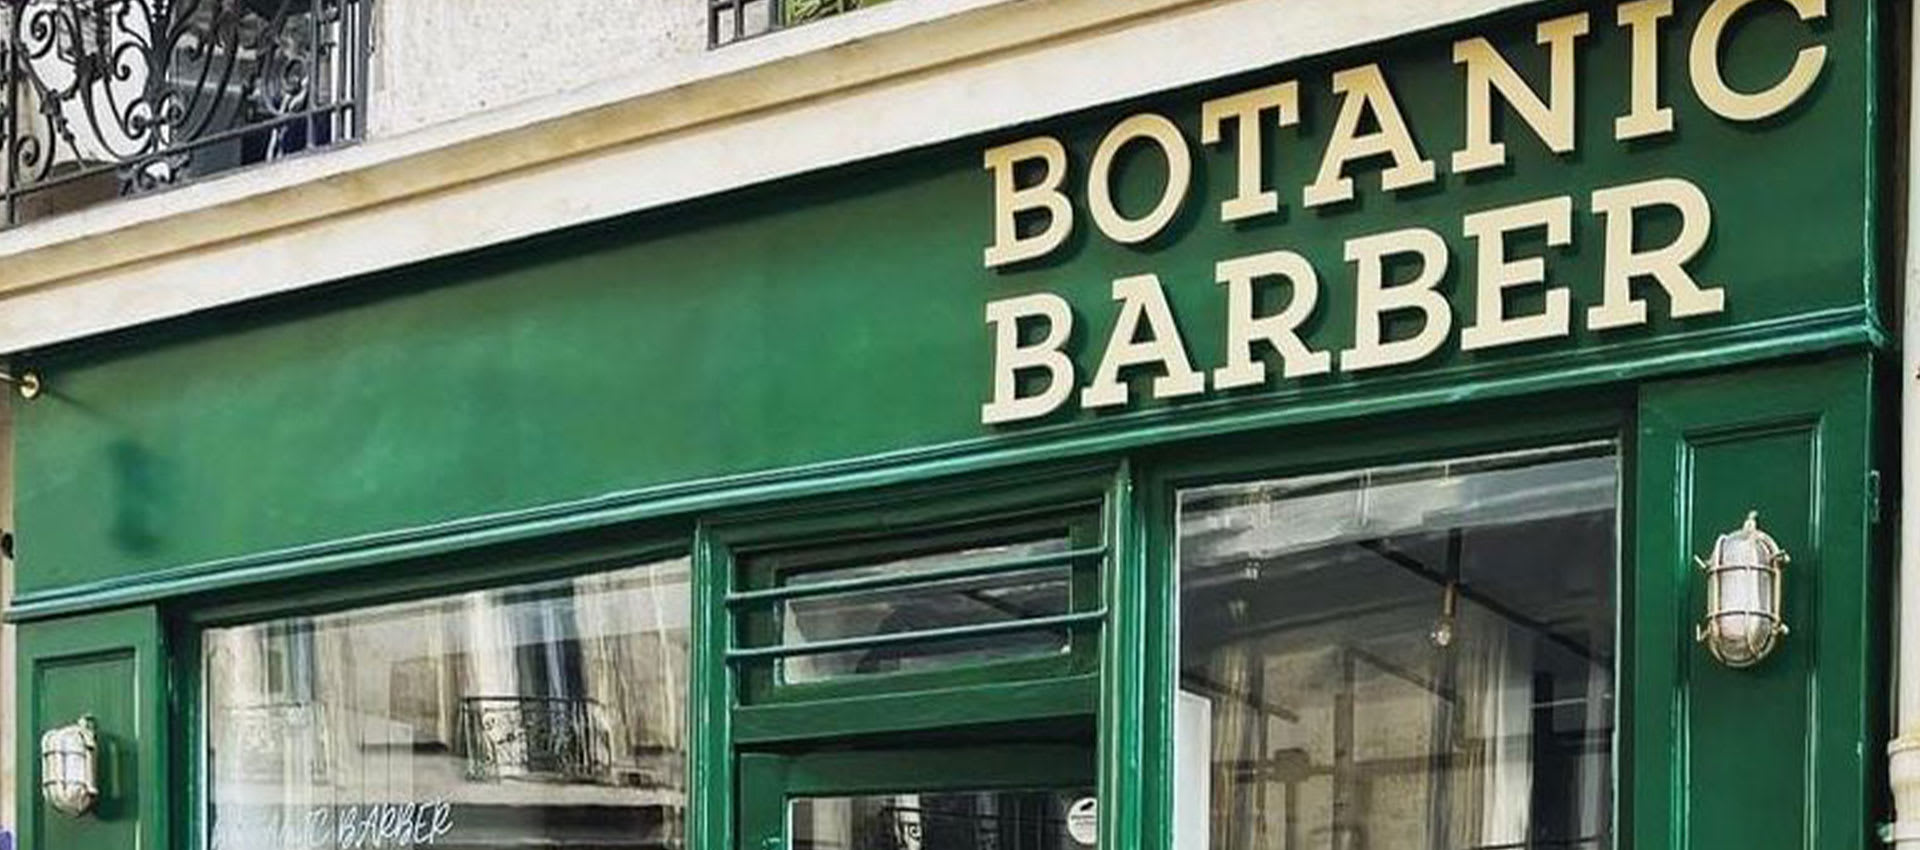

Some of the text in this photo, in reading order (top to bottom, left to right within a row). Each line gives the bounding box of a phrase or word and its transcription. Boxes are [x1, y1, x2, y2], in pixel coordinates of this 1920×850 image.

[984, 0, 1828, 267] BOTANIC
[981, 178, 1725, 424] BARBER
[338, 799, 453, 849] BARBER
